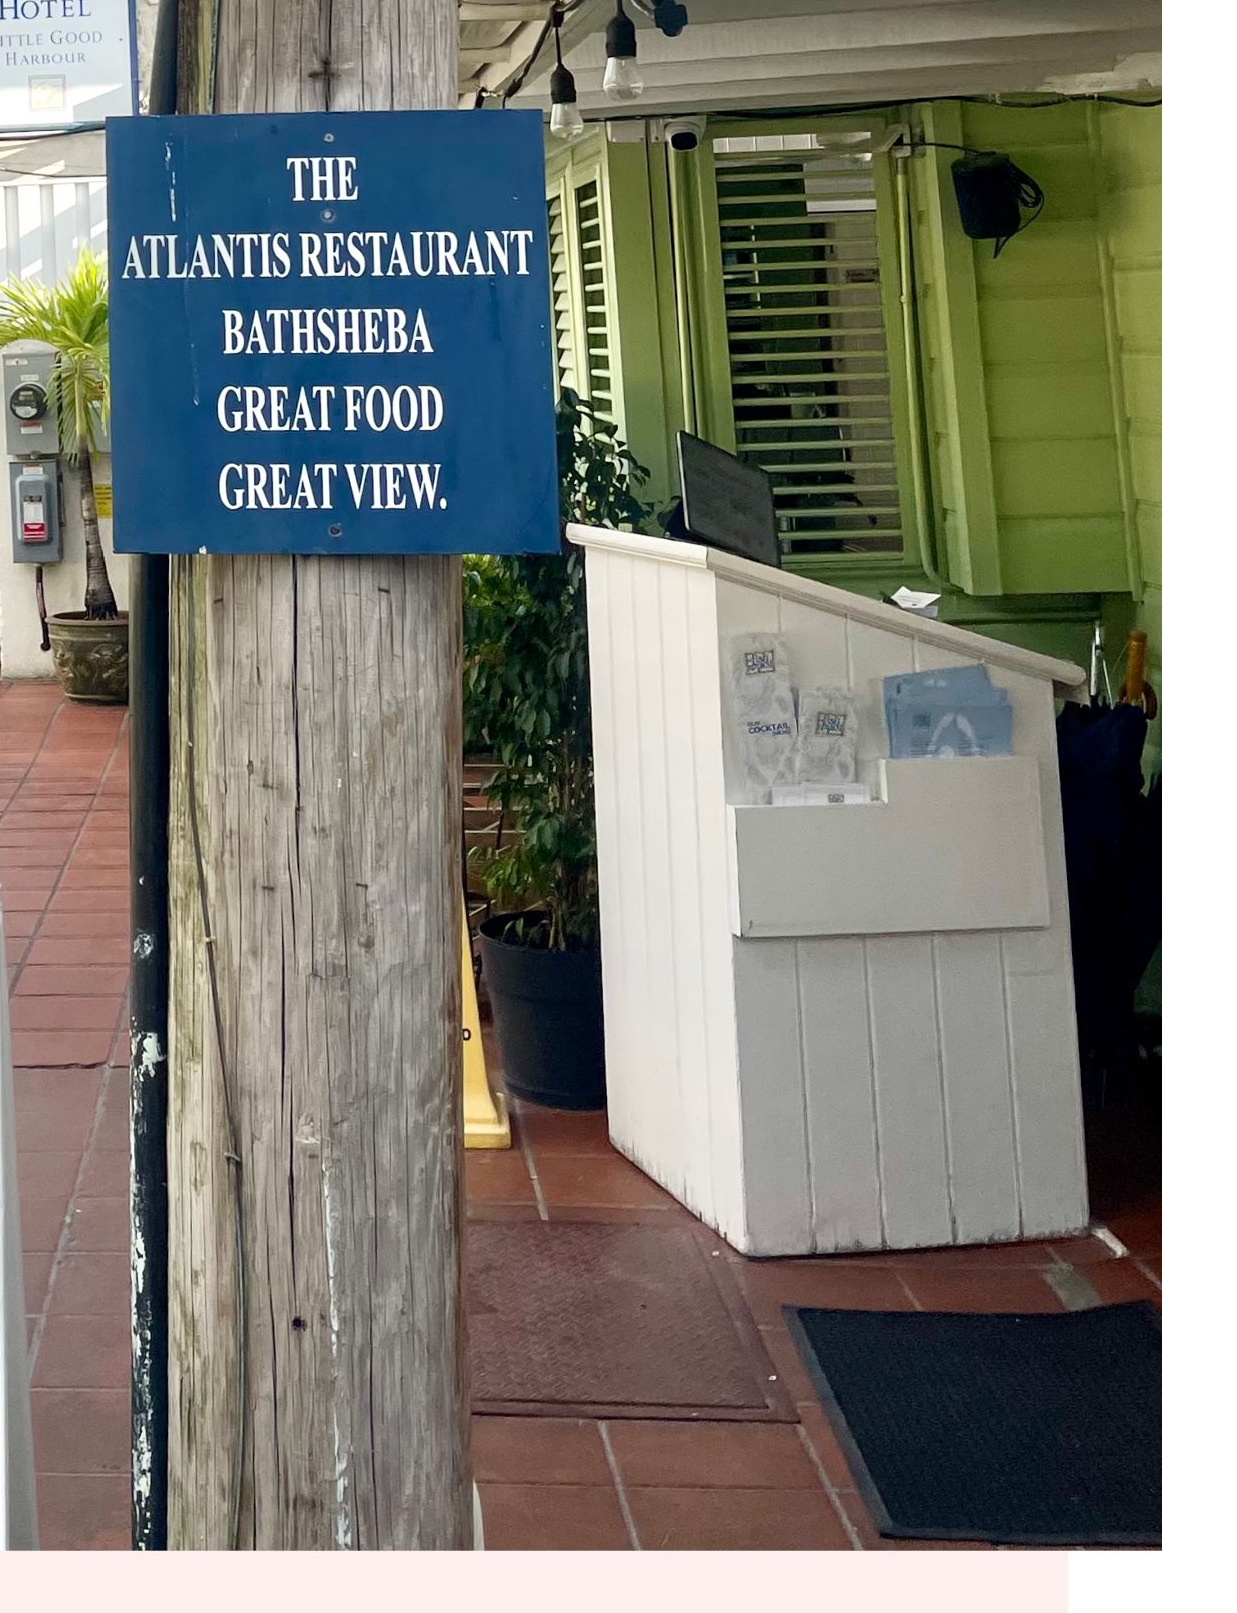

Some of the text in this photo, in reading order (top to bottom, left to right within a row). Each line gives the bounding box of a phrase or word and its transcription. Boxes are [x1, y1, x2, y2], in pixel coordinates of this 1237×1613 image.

[5, 51, 87, 67] HARBOUR
[50, 29, 103, 45] GOOD
[286, 156, 359, 203] THE
[121, 229, 534, 280] ATLANTIS RESTAURANT
[221, 307, 435, 356] BATHSHEBA
[216, 385, 445, 433] GREAT FOOD
[218, 462, 448, 511] GREAT VIEW.
[748, 722, 791, 735] COCKTAIL
